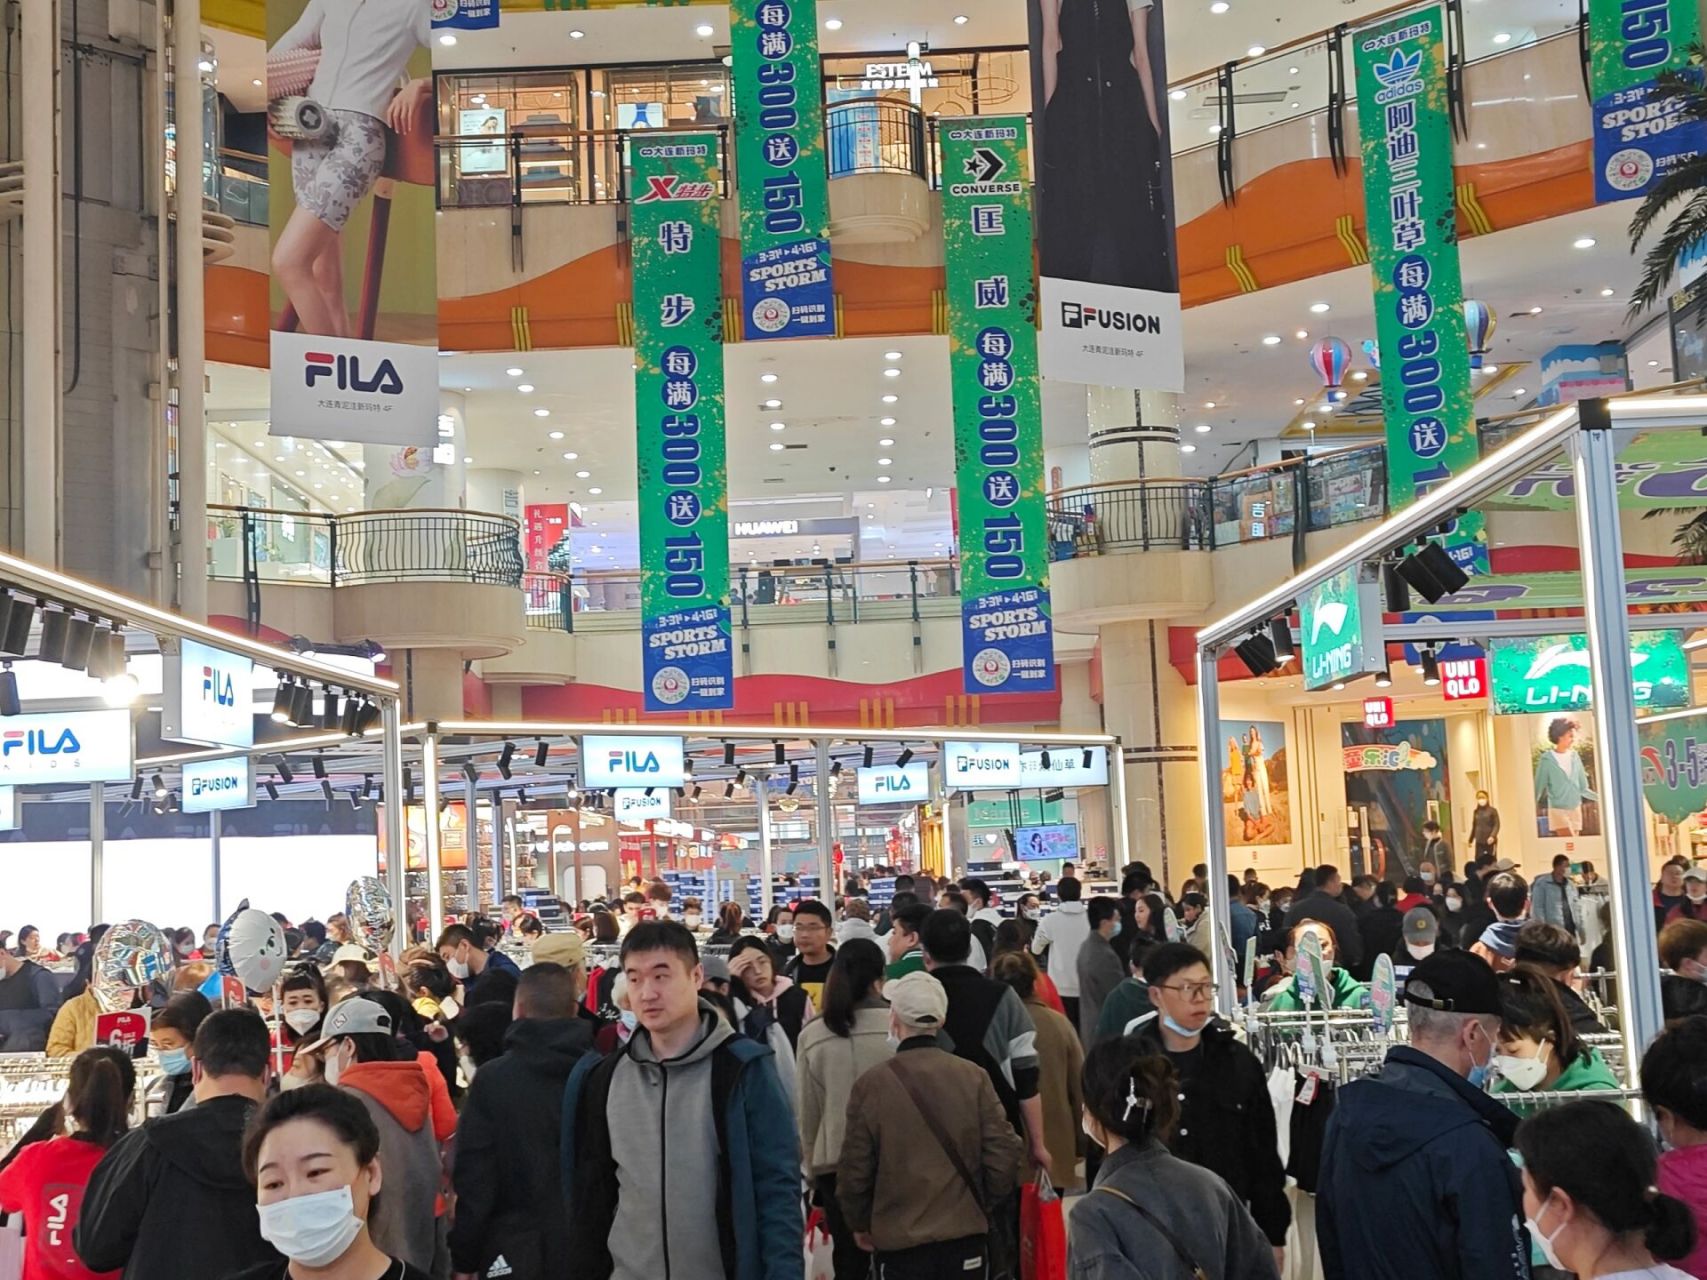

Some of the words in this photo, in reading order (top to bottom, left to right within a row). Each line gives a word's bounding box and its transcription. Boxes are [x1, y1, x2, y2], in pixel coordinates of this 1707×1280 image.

[1377, 81, 1423, 102] adidas
[961, 129, 1016, 140] 大连新玛特
[654, 145, 707, 156] 大连新玛特
[1388, 100, 1426, 251] 阿迪三叶草
[952, 183, 1020, 195] CONVERSE
[750, 256, 818, 282] SPORTS
[765, 268, 827, 292] STORM
[1083, 307, 1161, 335] FUSION
[305, 351, 404, 394] FILA
[735, 520, 798, 535] HUAWEI
[969, 607, 1038, 629] SPORTS
[649, 625, 717, 648] SPORTS
[984, 620, 1047, 642] STORM
[664, 638, 727, 660] STORM
[1312, 644, 1352, 679] LI-NING
[1445, 661, 1476, 677] UNI
[203, 666, 234, 707] FILA
[1447, 679, 1480, 697] QLO
[1525, 680, 1654, 706] LI-NG
[1365, 701, 1386, 713] UNI
[1366, 714, 1388, 726] QLO
[3, 728, 81, 757] FILA
[608, 750, 661, 773] FILA
[969, 760, 1010, 770] FUSION
[201, 776, 238, 792] FUSION
[875, 775, 911, 792] FILA
[630, 797, 661, 807] FUSION
